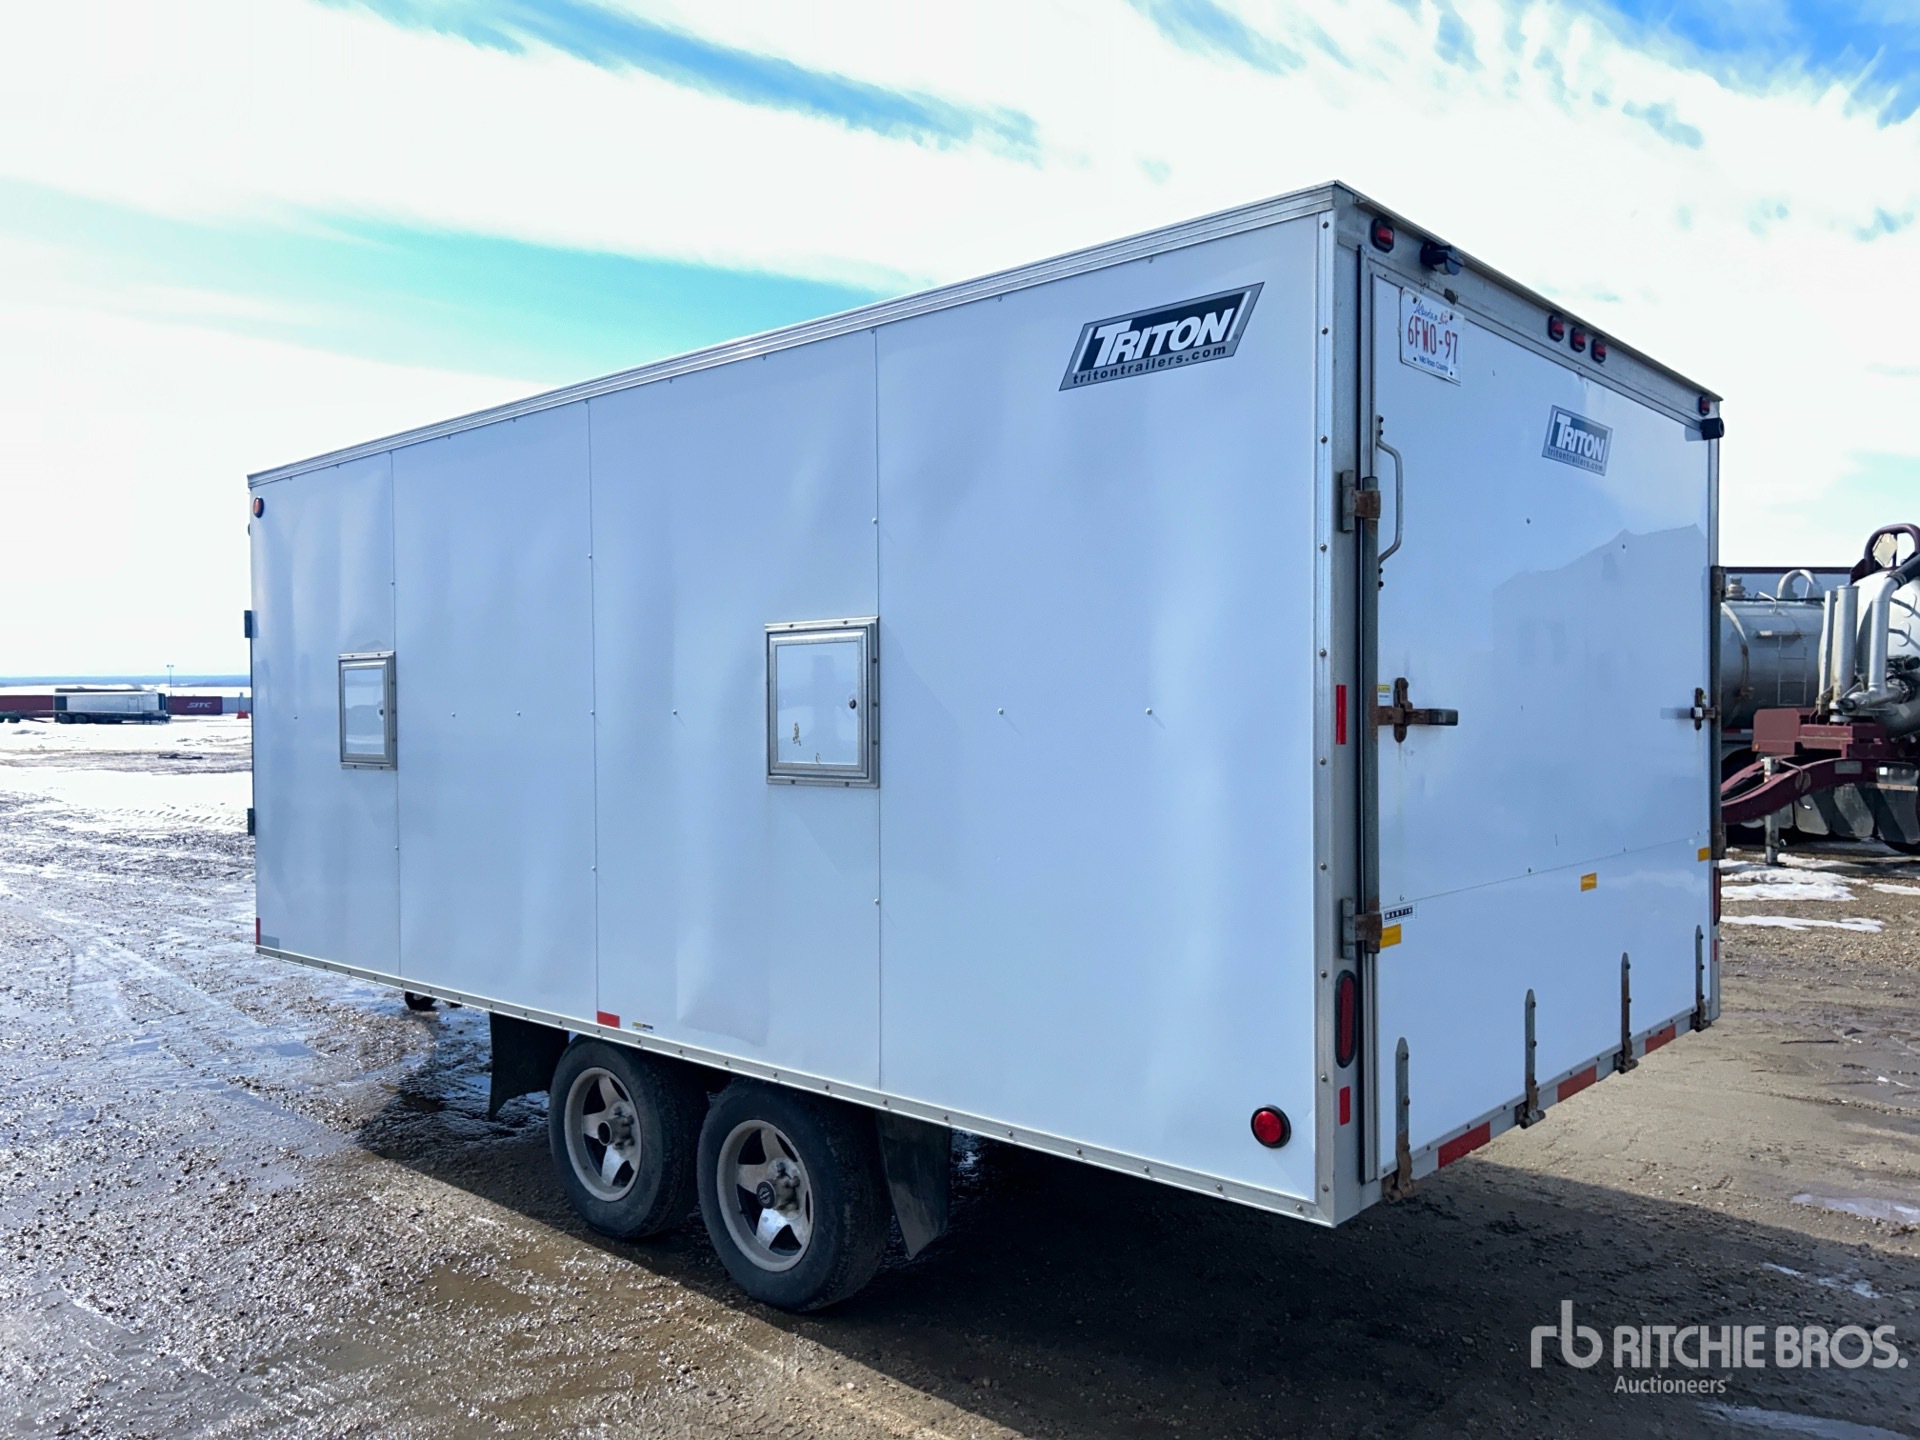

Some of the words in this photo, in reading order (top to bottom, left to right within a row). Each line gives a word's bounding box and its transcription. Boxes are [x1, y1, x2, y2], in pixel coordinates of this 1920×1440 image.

[1093, 308, 1235, 368] TRITON
[1073, 345, 1227, 385] tritontrailers.com
[1555, 413, 1605, 462] TRITON
[1547, 447, 1604, 472] tritontrailers.com
[187, 701, 212, 709] SITC
